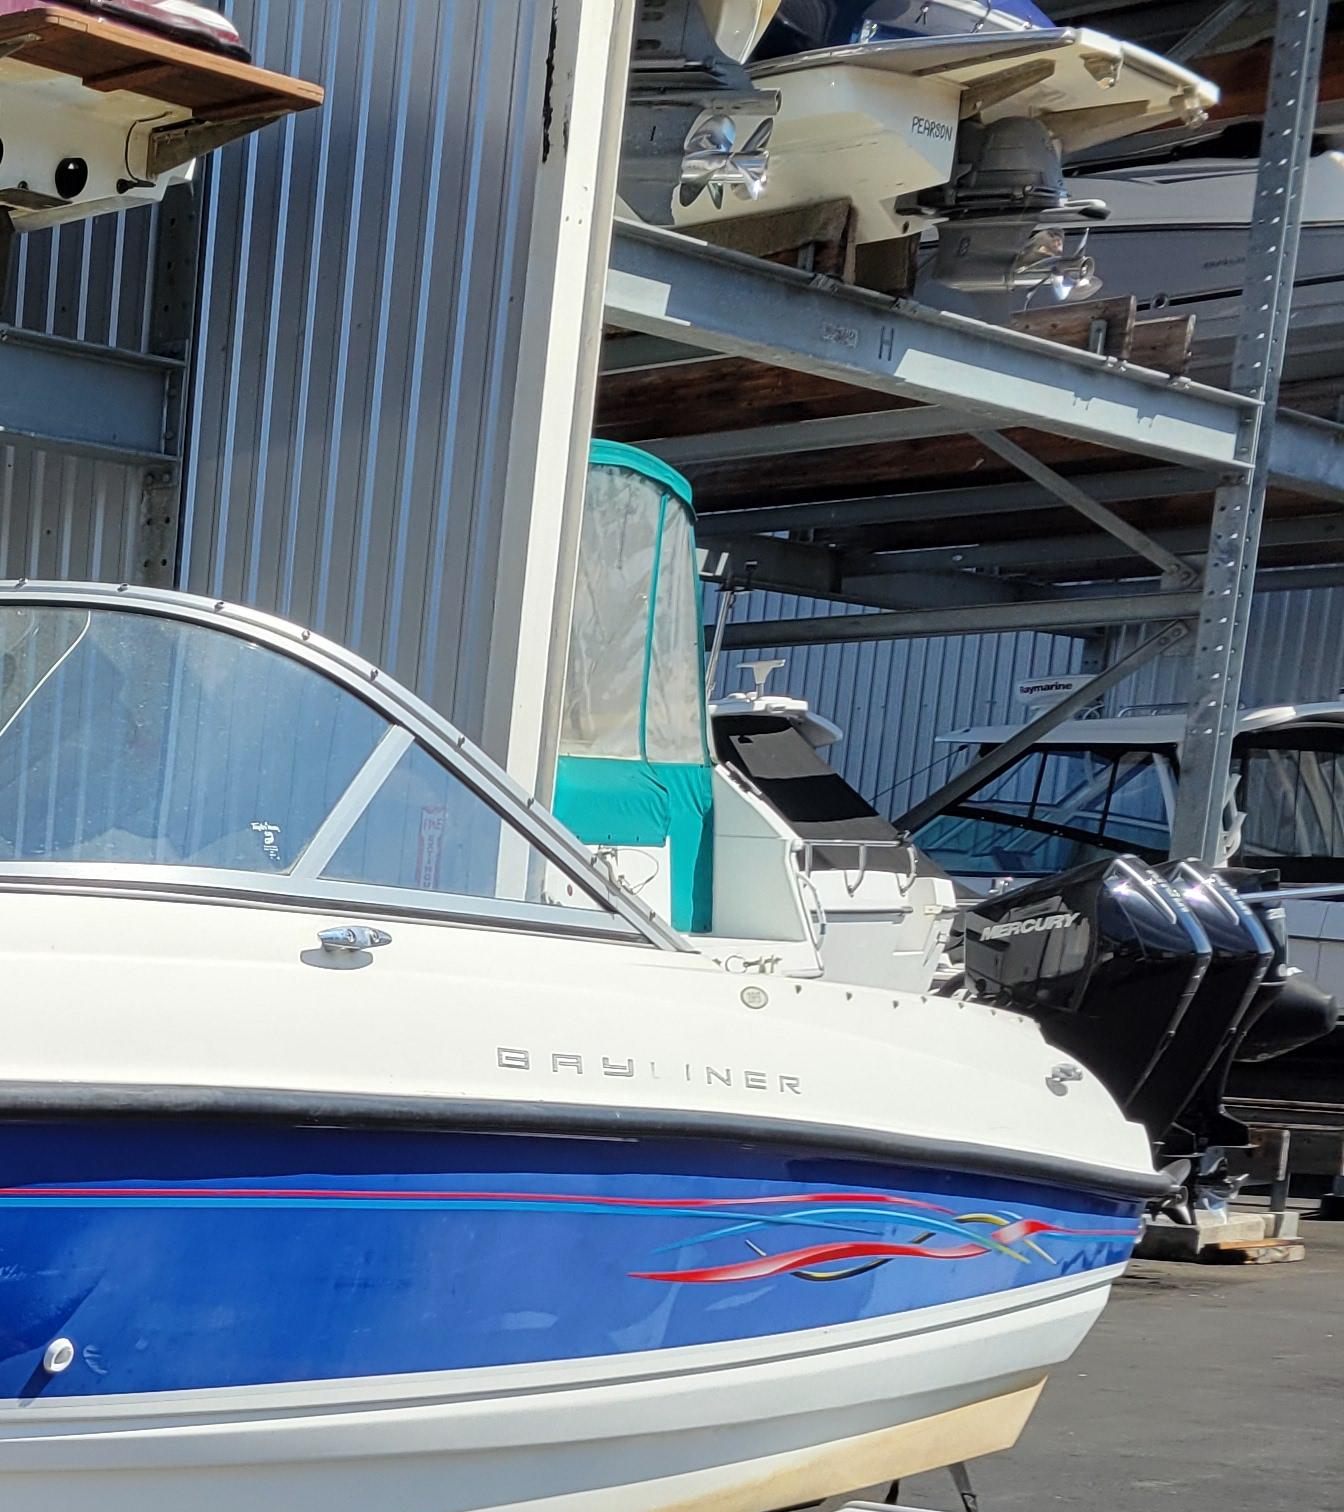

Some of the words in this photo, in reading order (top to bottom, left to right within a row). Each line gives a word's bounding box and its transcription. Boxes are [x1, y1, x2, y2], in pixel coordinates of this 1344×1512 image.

[912, 115, 953, 141] PEARSON
[879, 326, 894, 361] H
[979, 912, 1082, 942] MERCURY
[497, 1047, 802, 1095] BAYLINER
